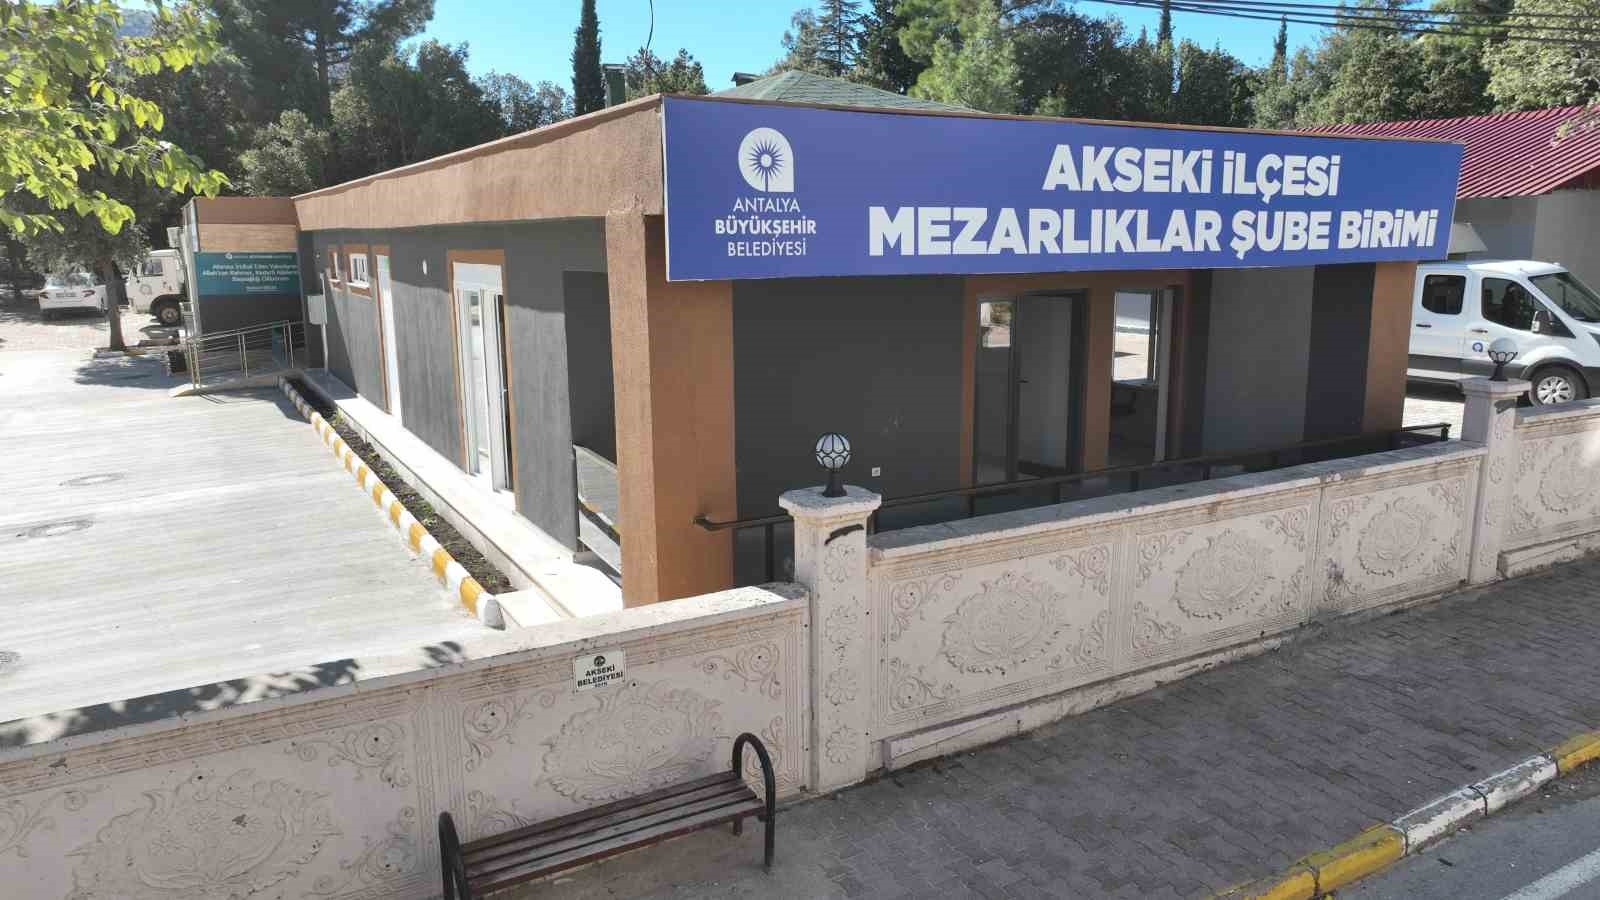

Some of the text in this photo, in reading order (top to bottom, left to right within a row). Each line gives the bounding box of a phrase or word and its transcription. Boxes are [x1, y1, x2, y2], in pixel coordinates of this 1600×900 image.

[1042, 144, 1341, 204] AKSEKİ İLÇESİ
[733, 198, 801, 213] ANTALYA
[715, 215, 817, 238] BÜYÜKŞEHİR
[869, 206, 1439, 260] MEZARLIKLAR ŞUBE BİRİMİ
[728, 237, 807, 257] BELEDİYESİ
